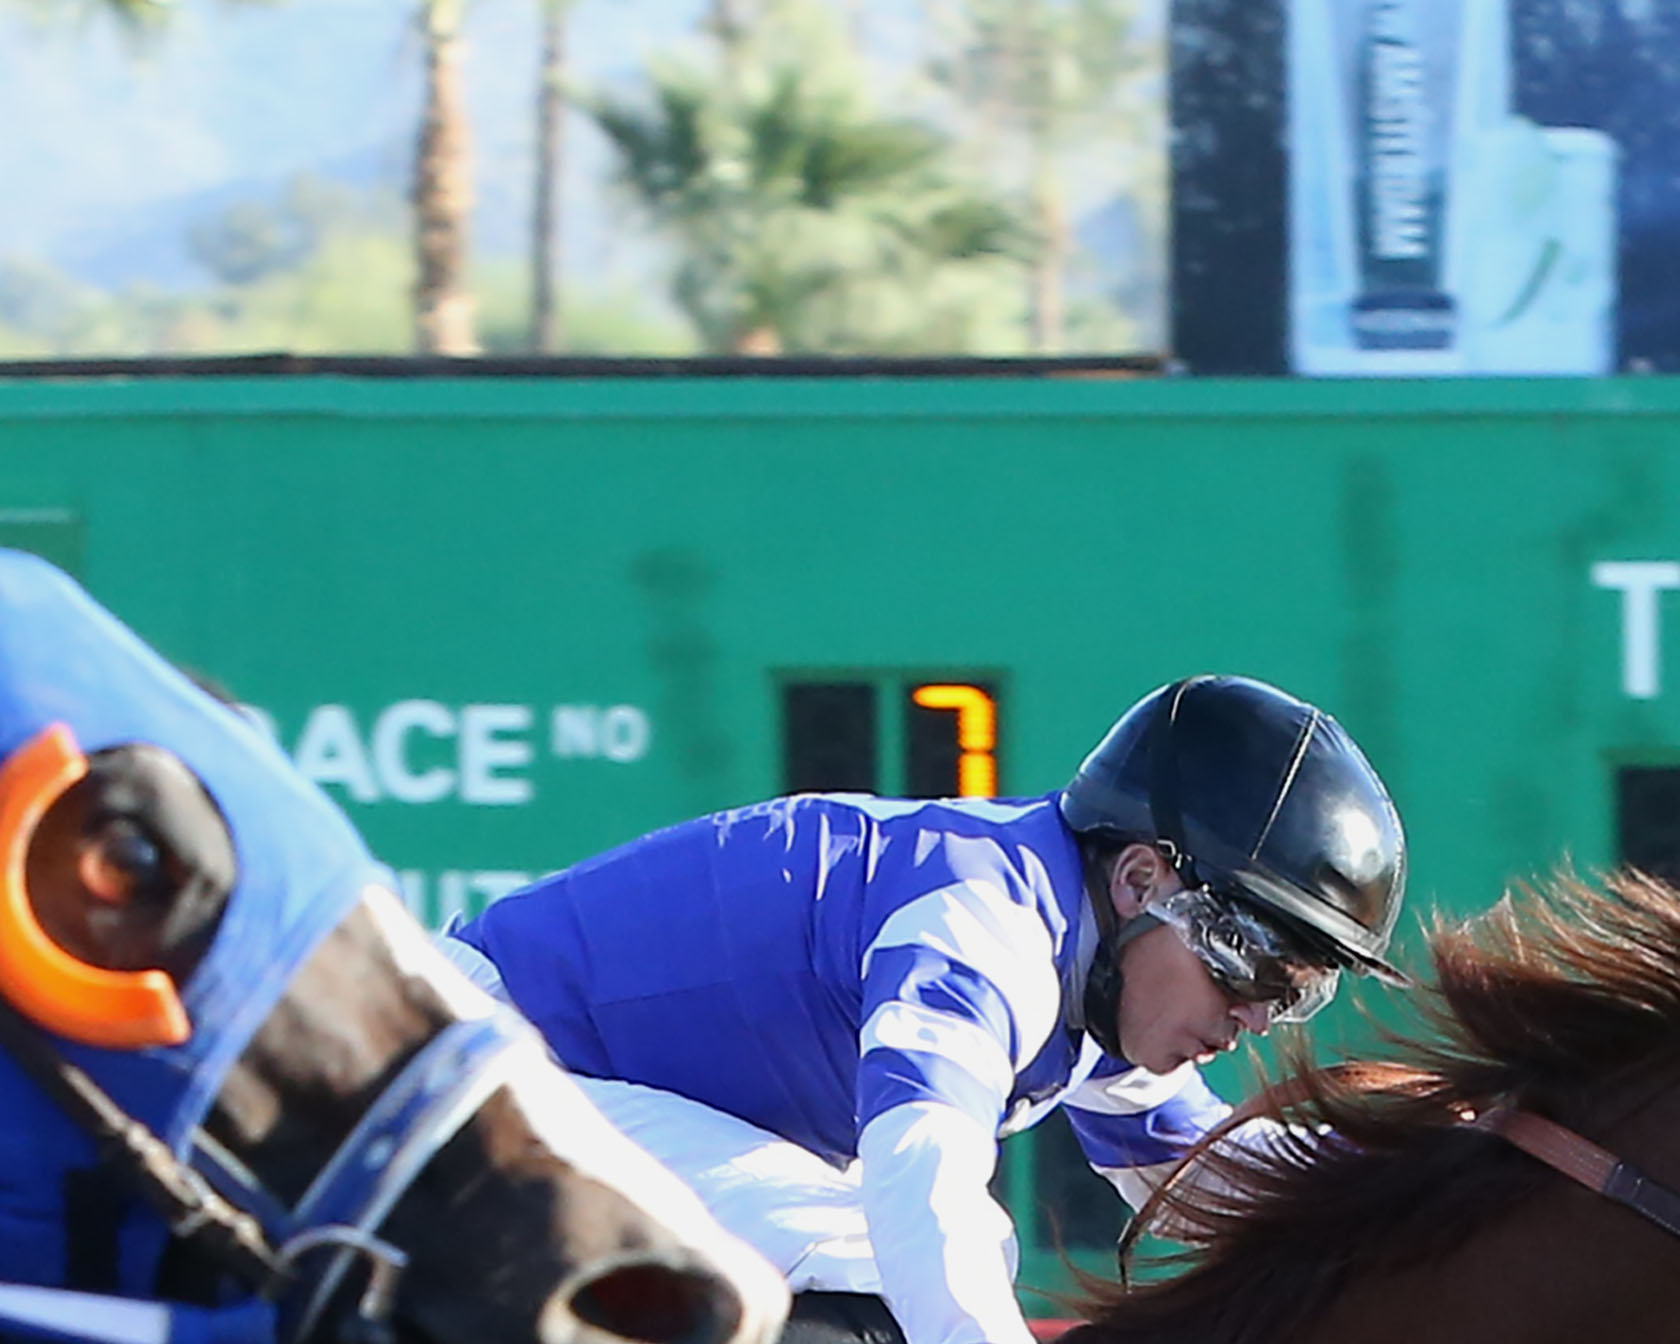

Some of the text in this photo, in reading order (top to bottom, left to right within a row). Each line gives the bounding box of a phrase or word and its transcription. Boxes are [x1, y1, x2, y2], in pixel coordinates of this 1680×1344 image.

[250, 698, 651, 804] ACE NO
[912, 683, 998, 799] 7
